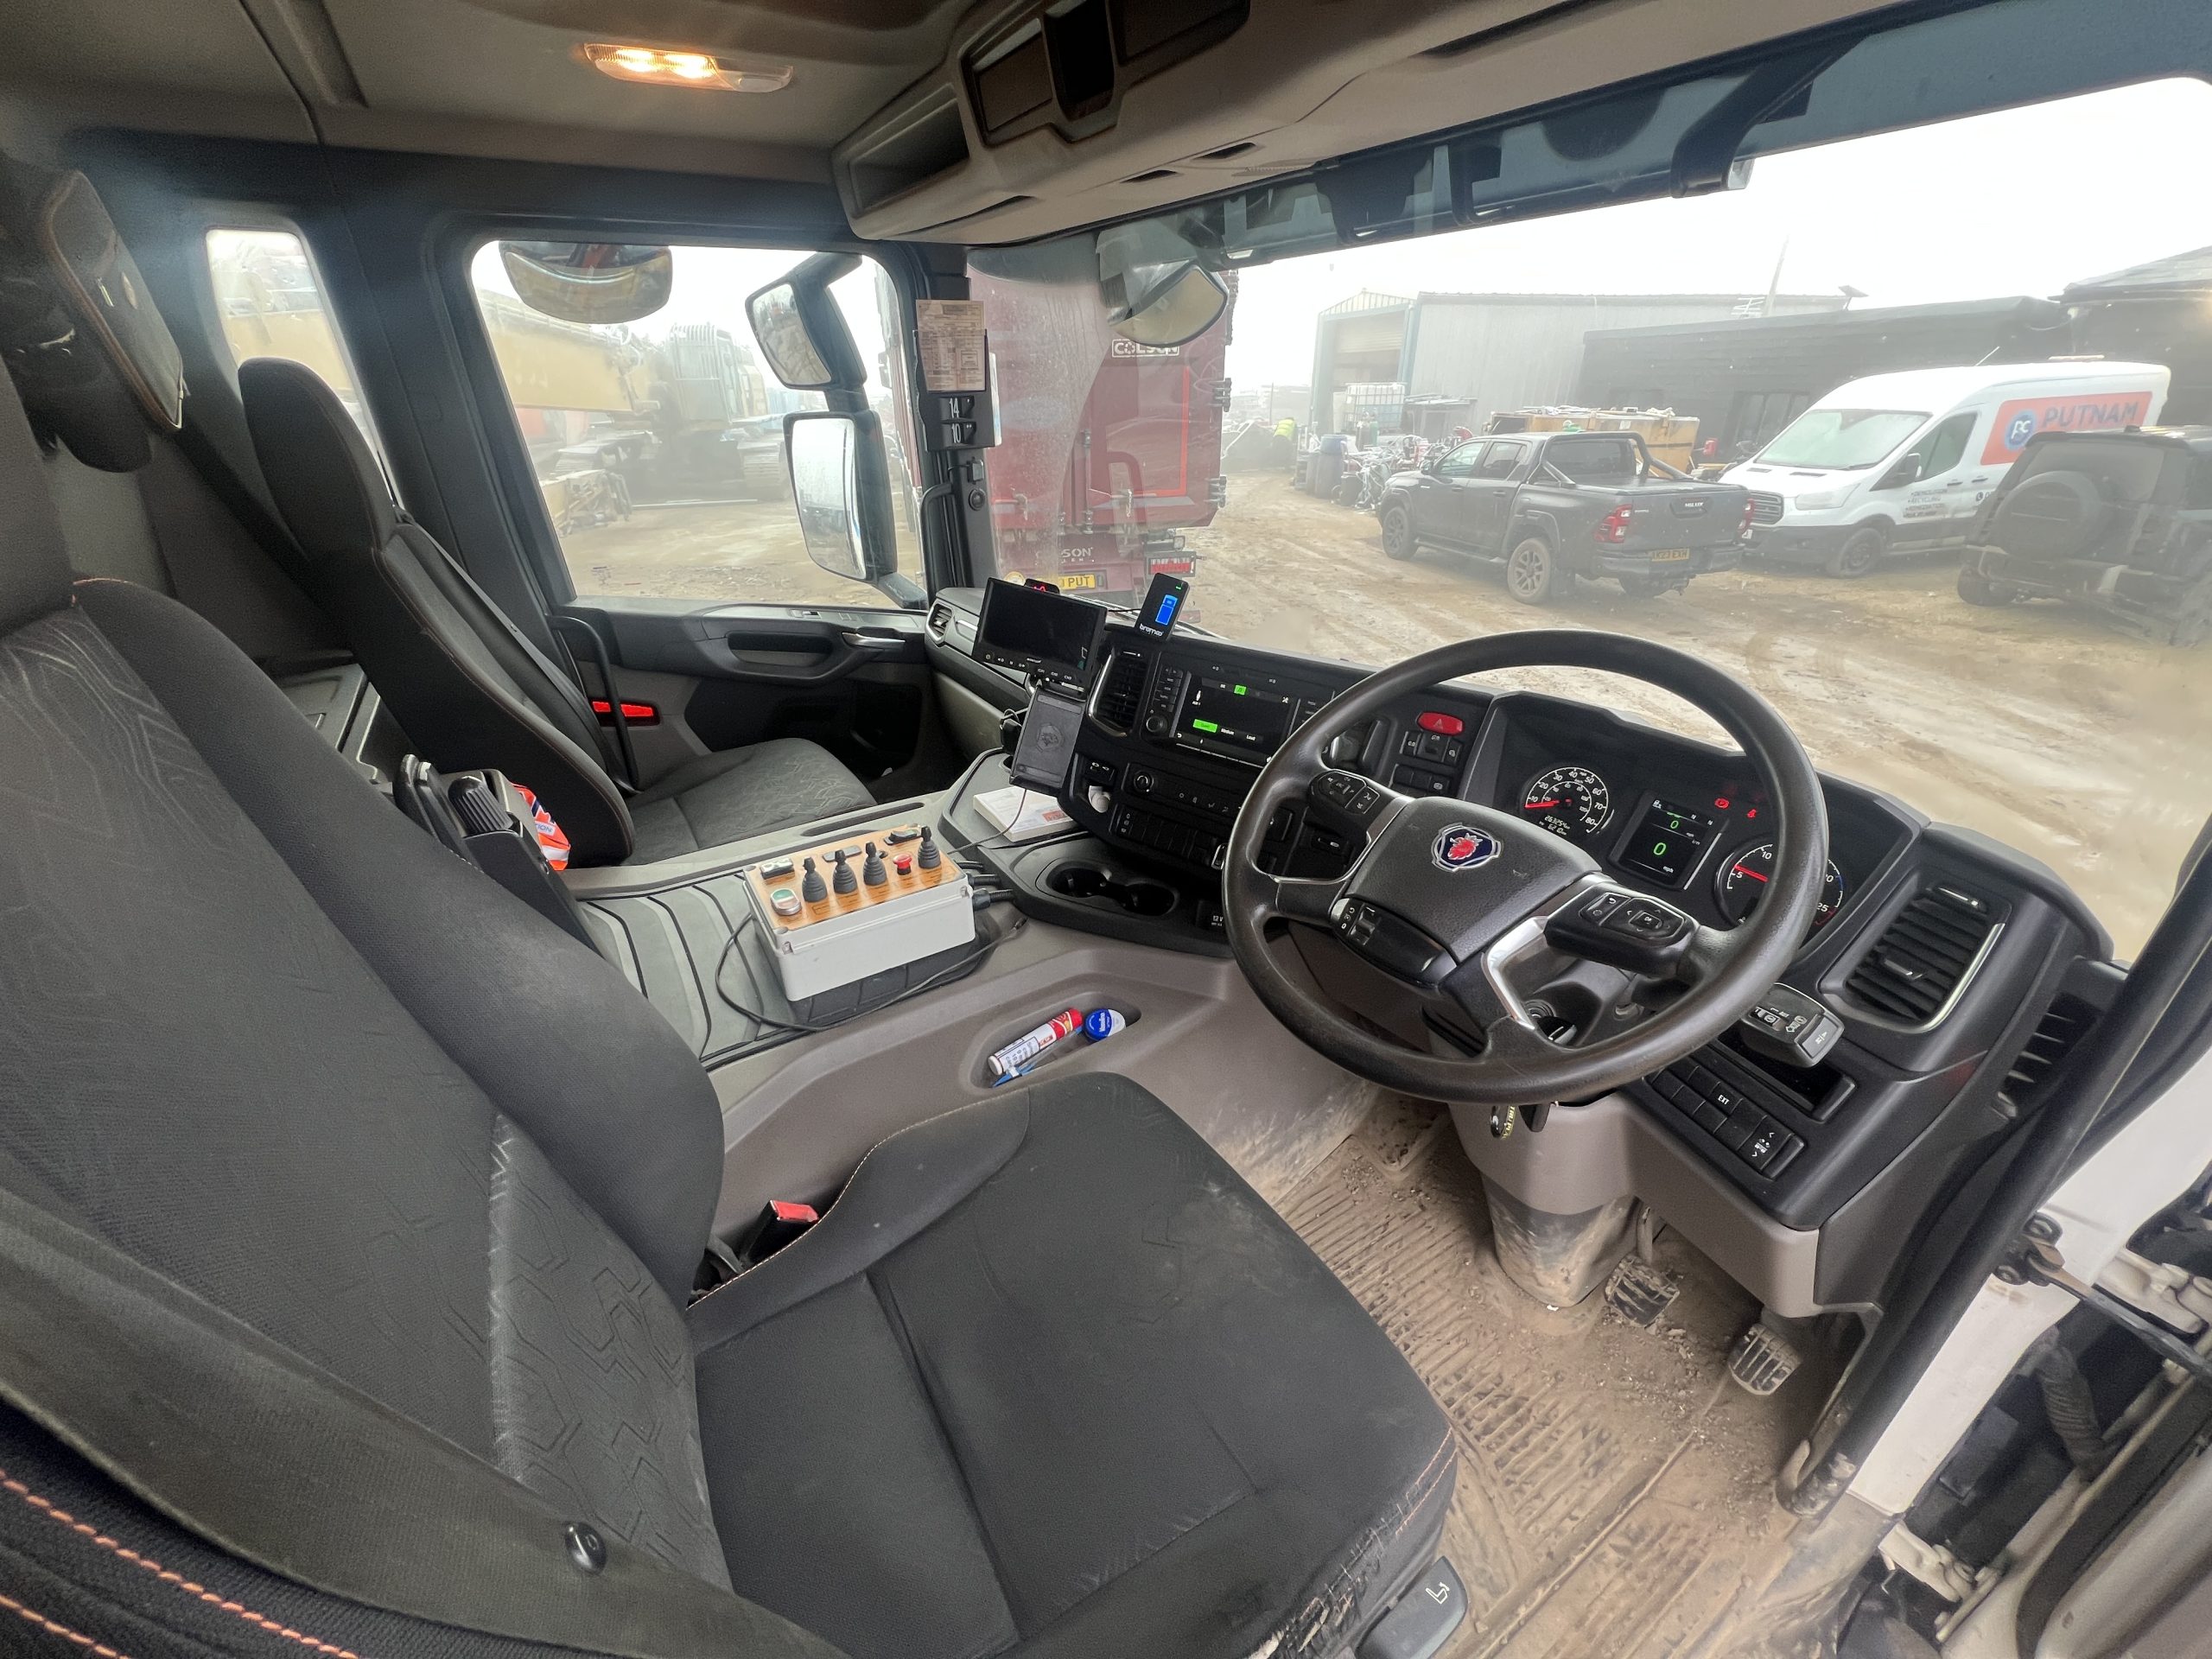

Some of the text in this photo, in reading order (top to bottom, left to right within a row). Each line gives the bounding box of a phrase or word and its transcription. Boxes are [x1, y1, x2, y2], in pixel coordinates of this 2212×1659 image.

[949, 397, 959, 418] 14
[2043, 402, 2139, 428] PUTNAM
[951, 423, 961, 443] 10
[1068, 576, 1090, 587] PUT
[1670, 820, 1679, 829] 0
[1654, 842, 1666, 855] 0
[1762, 850, 1772, 859] 10
[1826, 874, 1834, 882] 0
